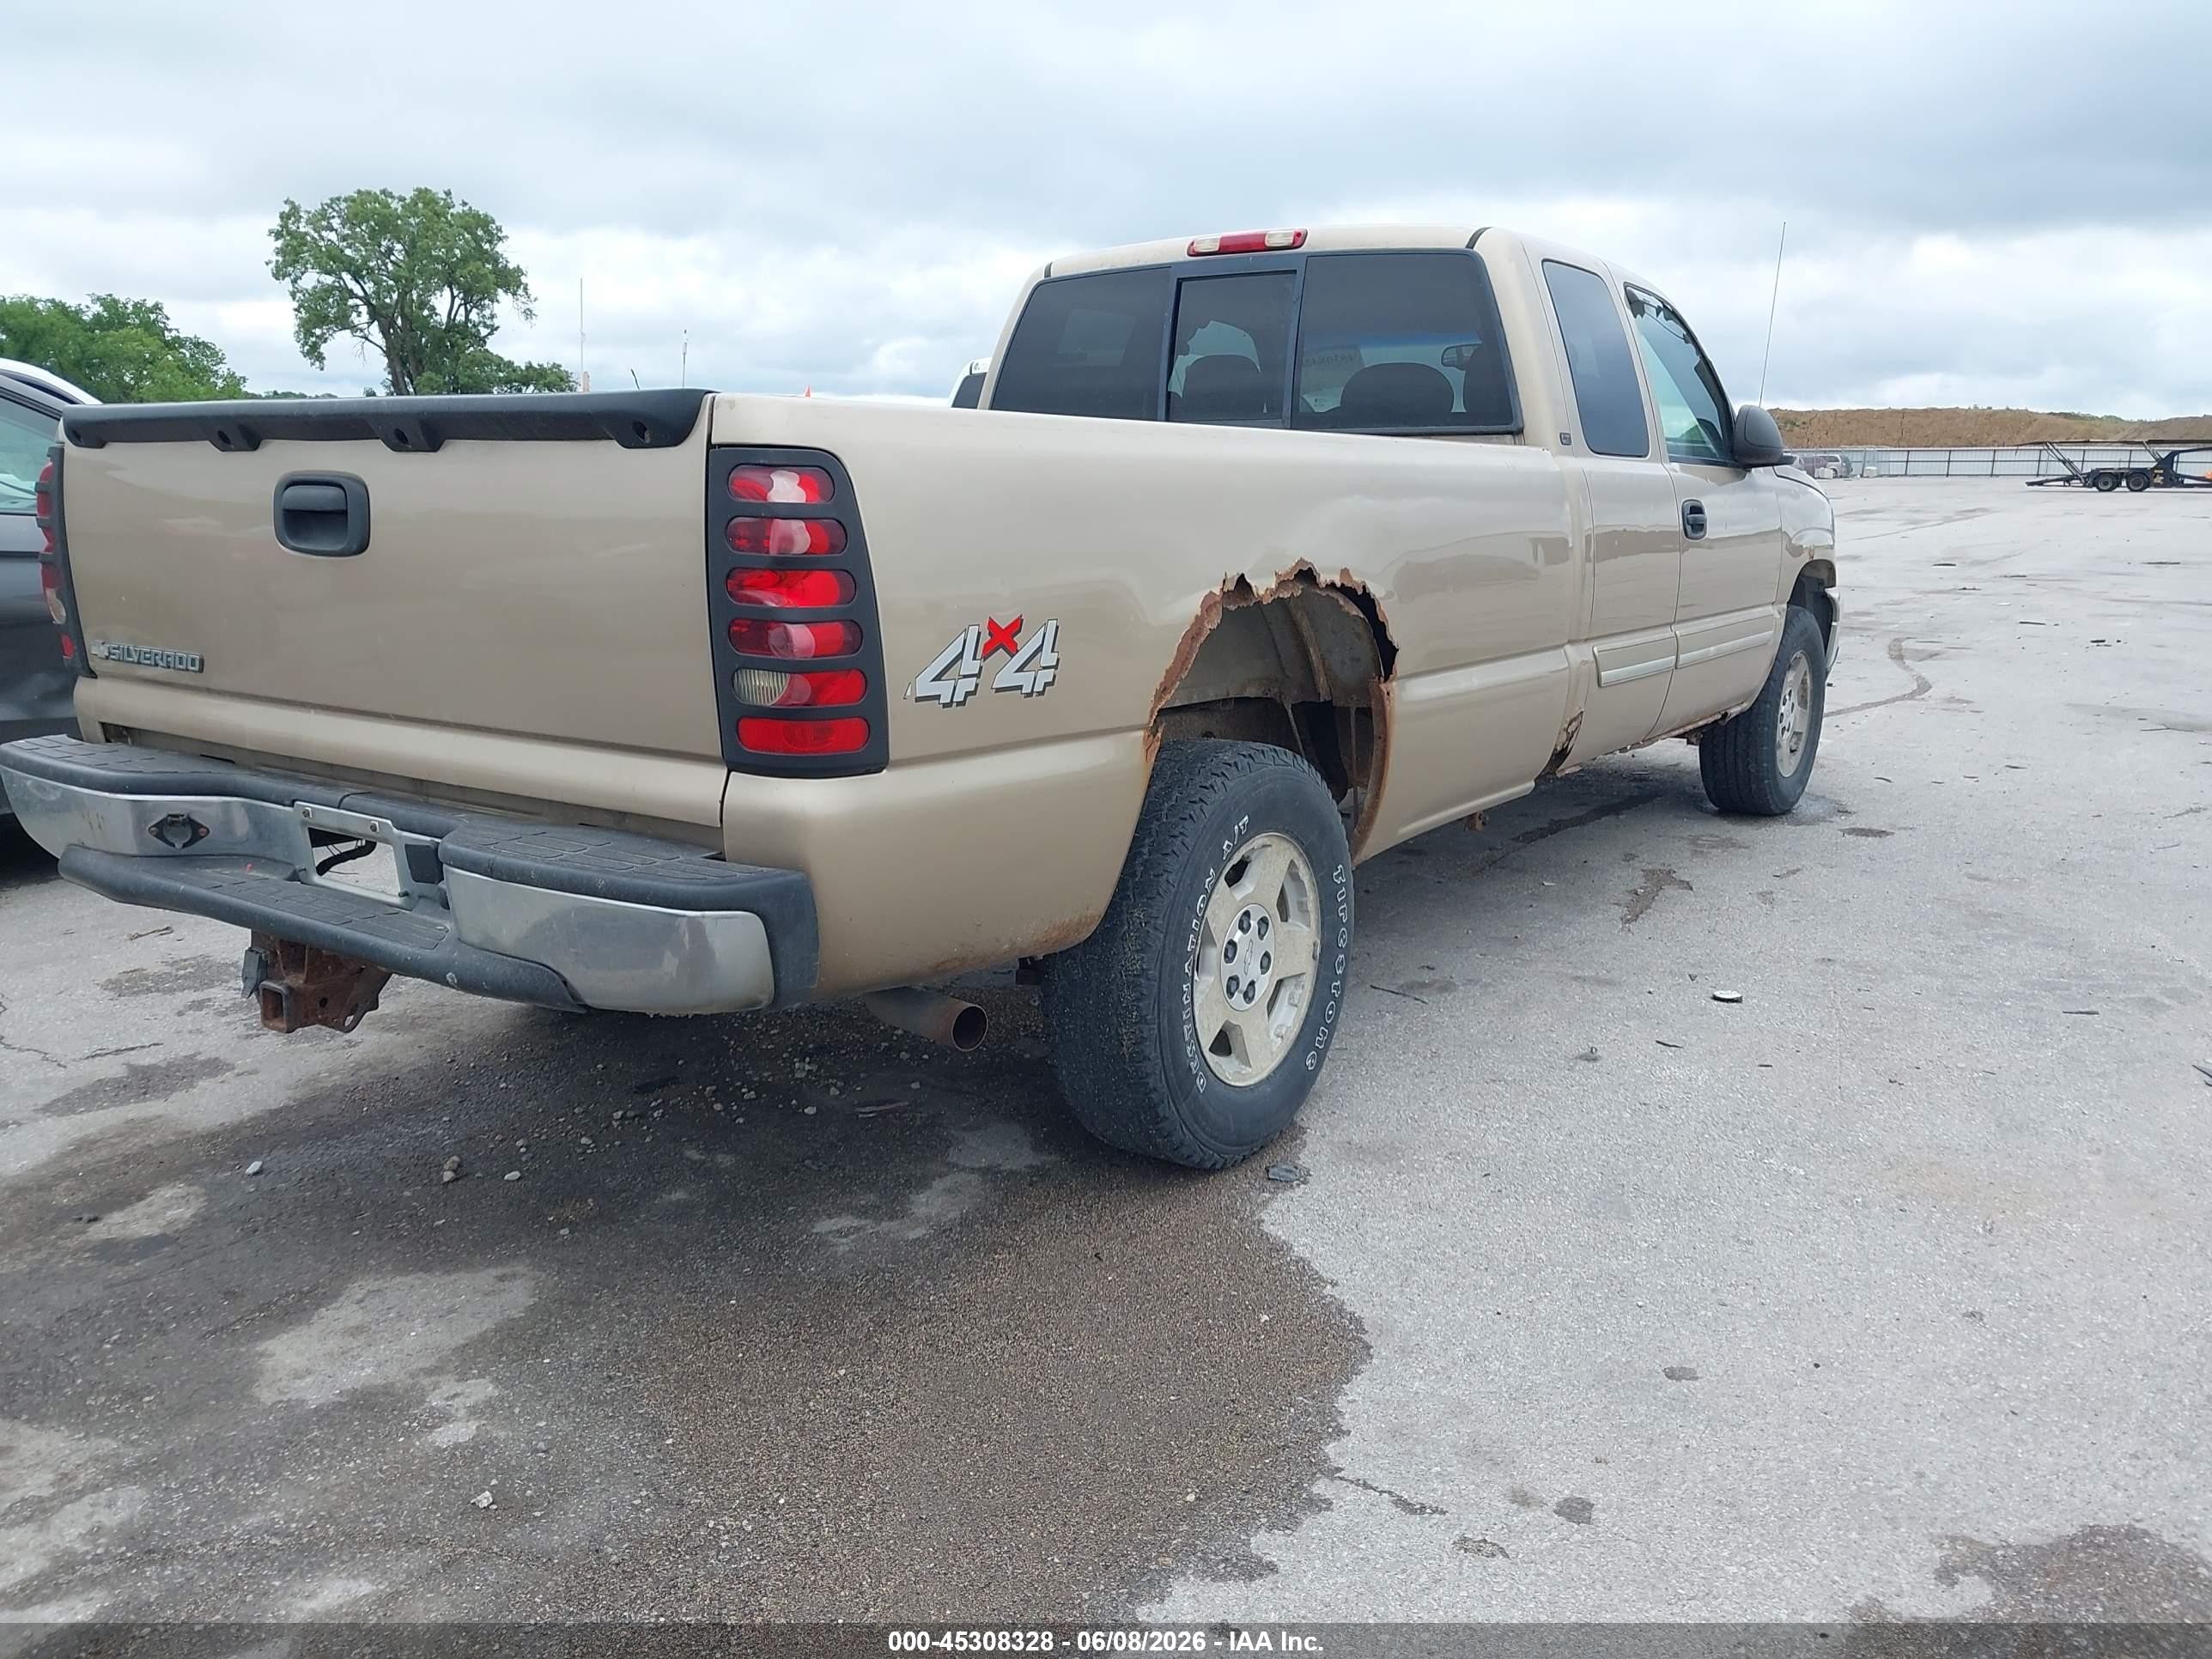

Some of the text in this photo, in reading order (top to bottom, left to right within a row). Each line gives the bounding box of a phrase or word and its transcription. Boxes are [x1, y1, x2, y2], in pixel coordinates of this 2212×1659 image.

[109, 644, 200, 672] SILVERADO
[1182, 815, 1249, 1093] DESTINATION A/T
